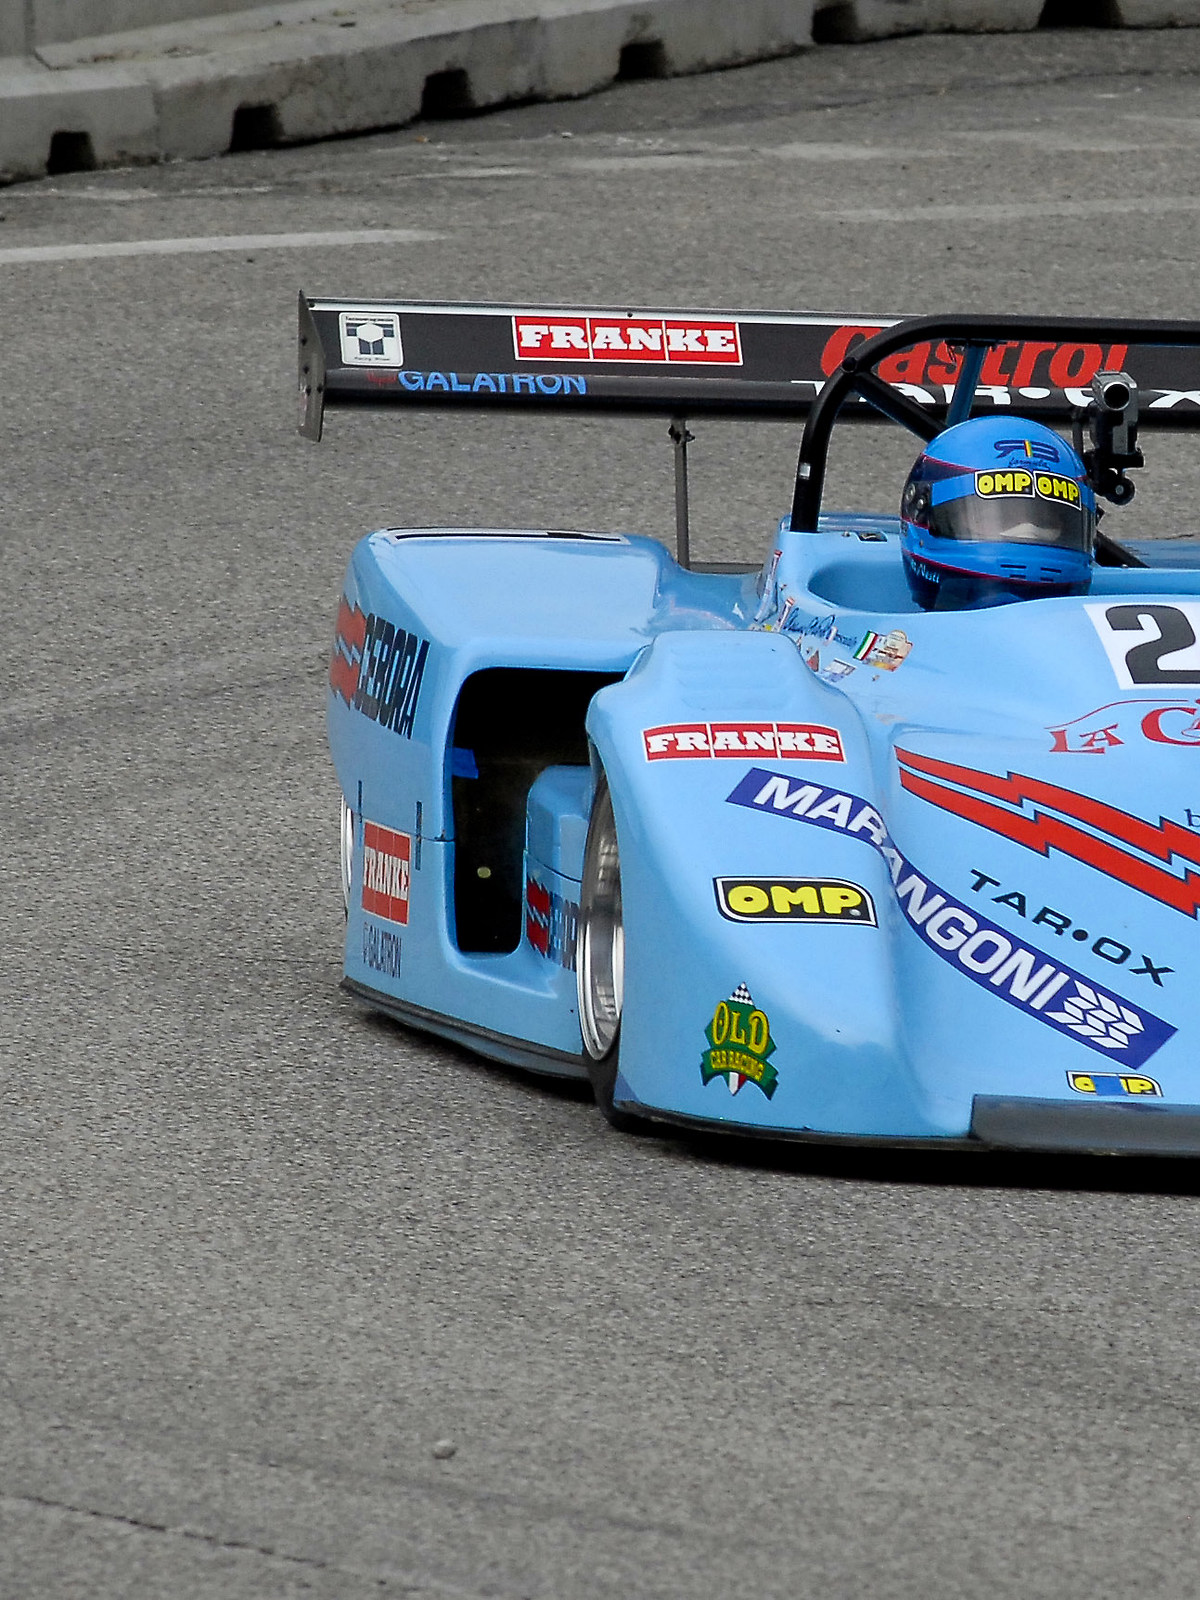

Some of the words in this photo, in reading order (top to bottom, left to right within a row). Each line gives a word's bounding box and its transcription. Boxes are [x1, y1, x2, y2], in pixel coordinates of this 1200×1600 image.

[520, 322, 736, 353] FRANKE
[399, 371, 587, 396] GALATRON
[978, 473, 1032, 494] OMP
[1037, 476, 1079, 501] OMP
[355, 613, 430, 740] CEBORA
[646, 731, 840, 754] FRANKE
[363, 846, 409, 901] FRANKE
[728, 885, 862, 915] OMP
[753, 776, 1070, 1011] MARANGONI
[712, 1001, 770, 1054] OLD
